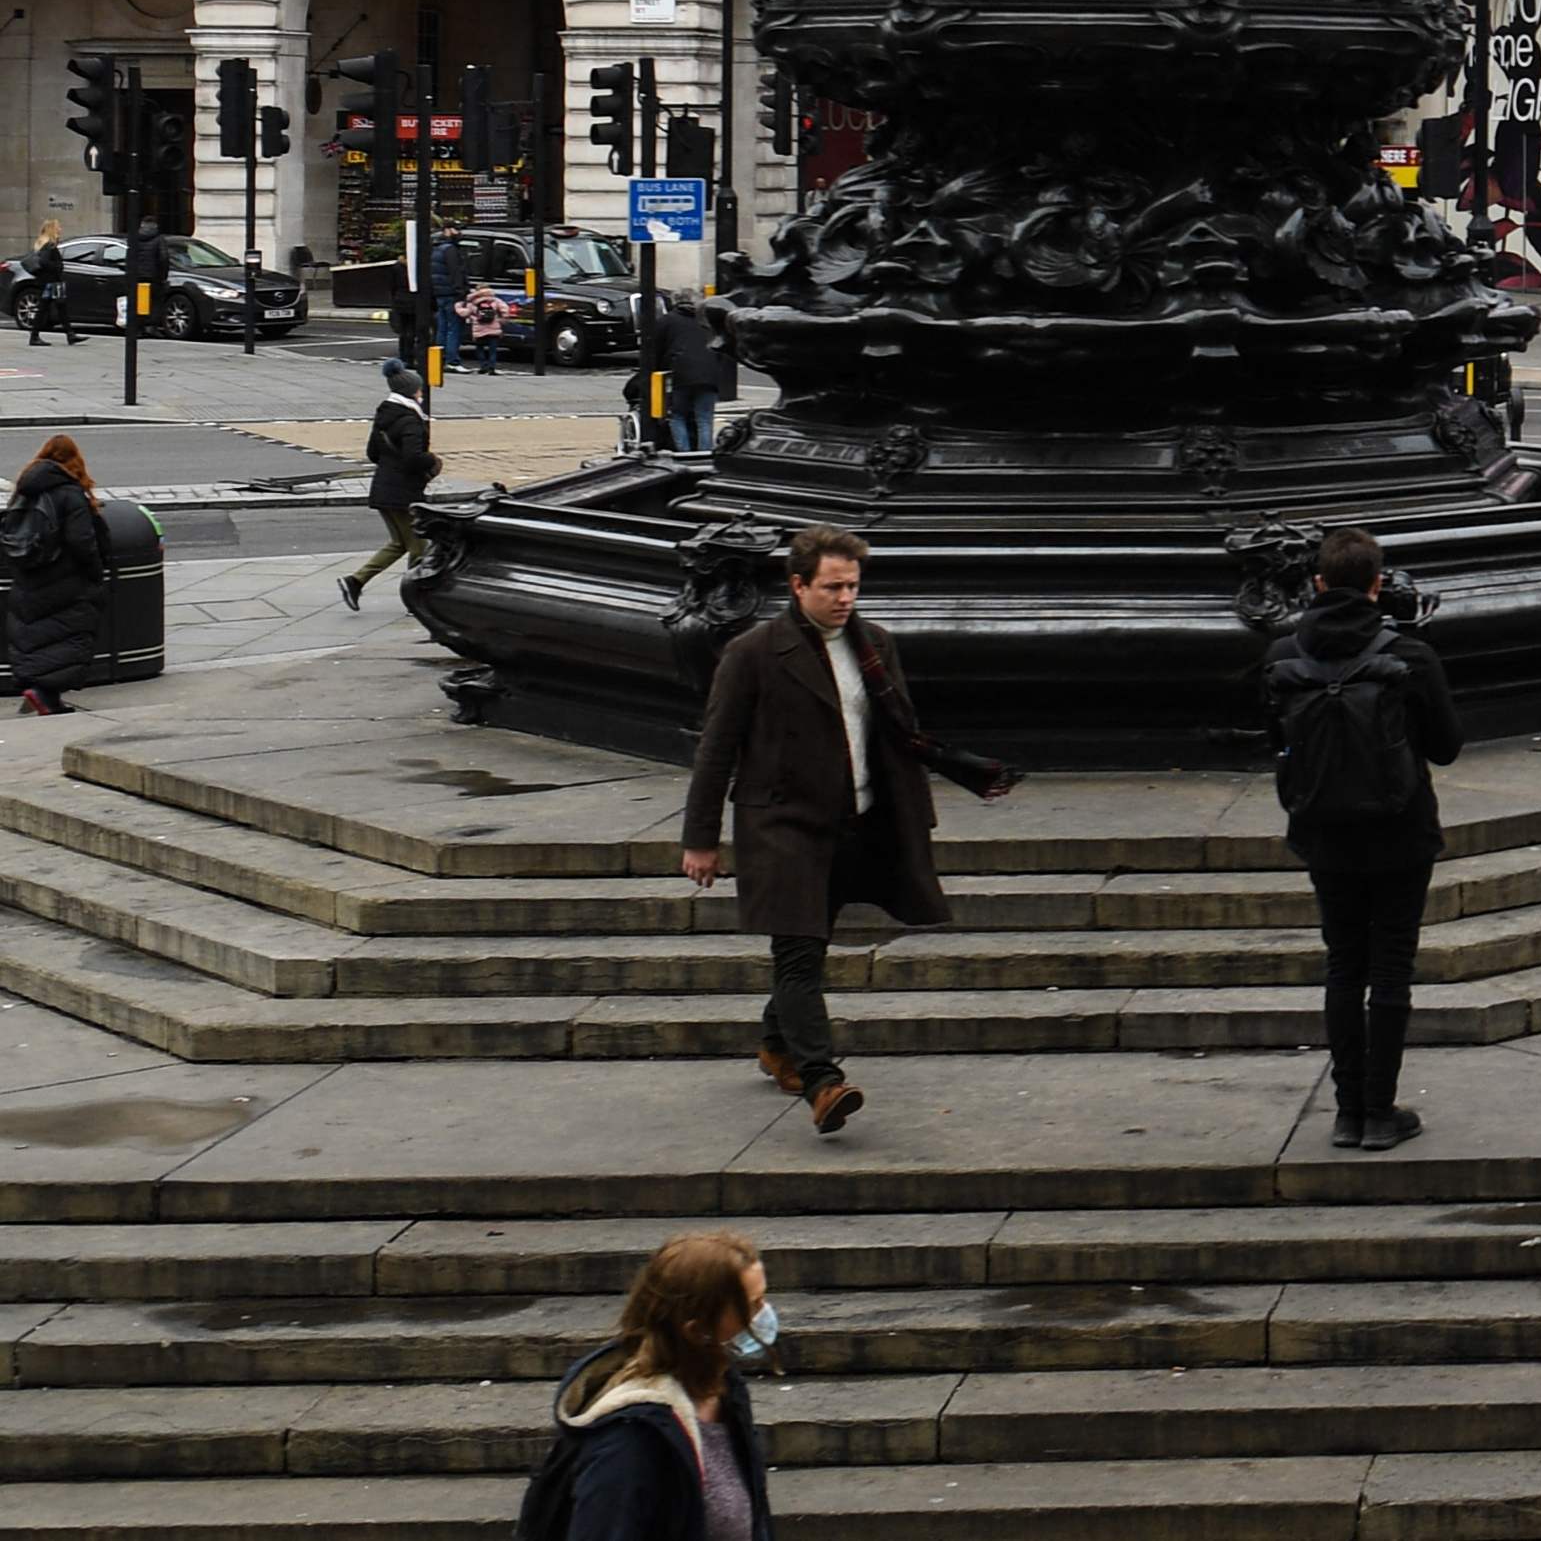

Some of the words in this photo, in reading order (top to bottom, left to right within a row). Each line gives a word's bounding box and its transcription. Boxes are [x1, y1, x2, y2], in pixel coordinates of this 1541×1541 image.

[637, 183, 662, 192] BUS
[665, 183, 695, 192] LANE
[667, 217, 700, 226] BOTH
